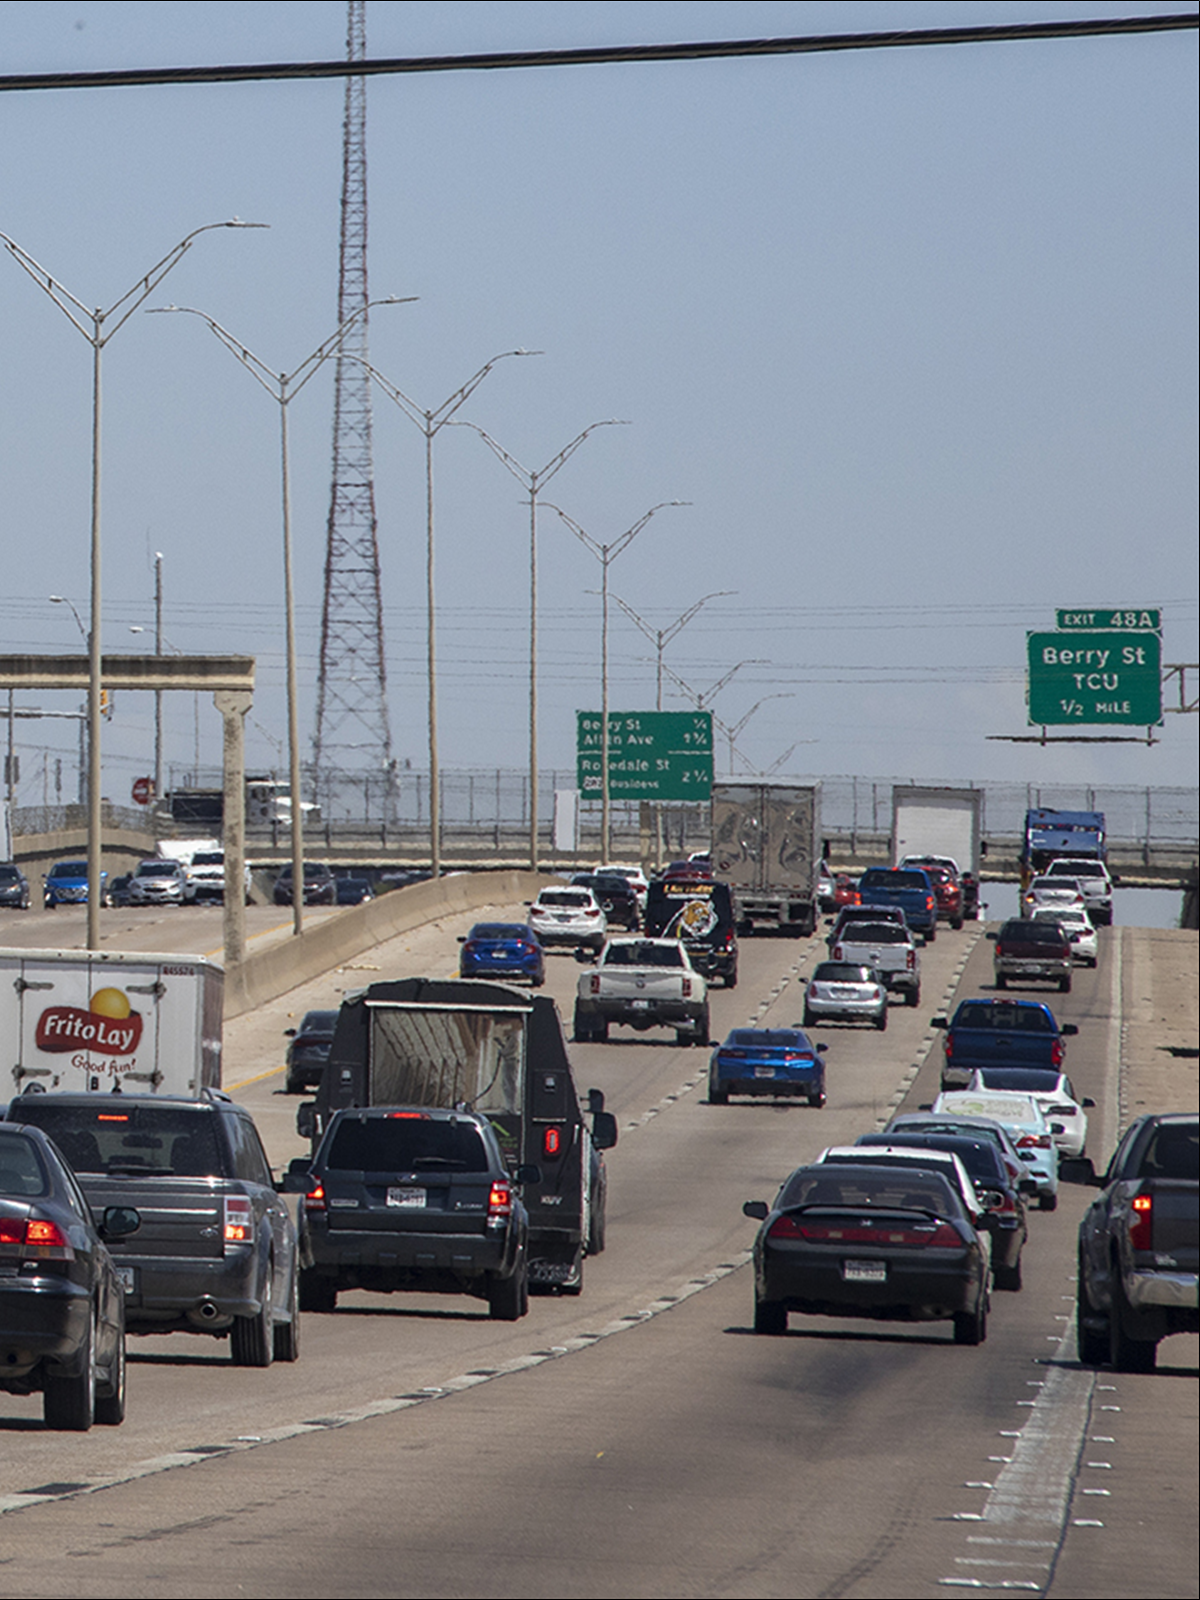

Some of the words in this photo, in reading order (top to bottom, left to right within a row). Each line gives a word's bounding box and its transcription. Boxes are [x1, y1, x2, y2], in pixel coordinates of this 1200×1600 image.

[1063, 613, 1096, 625] EXIT
[1110, 612, 1153, 627] 48A
[1042, 647, 1110, 669] Berry
[1122, 647, 1146, 665] St
[1073, 673, 1119, 691] TCU
[1096, 702, 1131, 714] MILE
[582, 719, 622, 732] Bery
[626, 718, 641, 730] St
[627, 734, 654, 745] Ave
[581, 759, 649, 772] Roedale
[656, 759, 670, 771] St
[71, 1054, 106, 1072] Good
[107, 1058, 136, 1077] fun!
